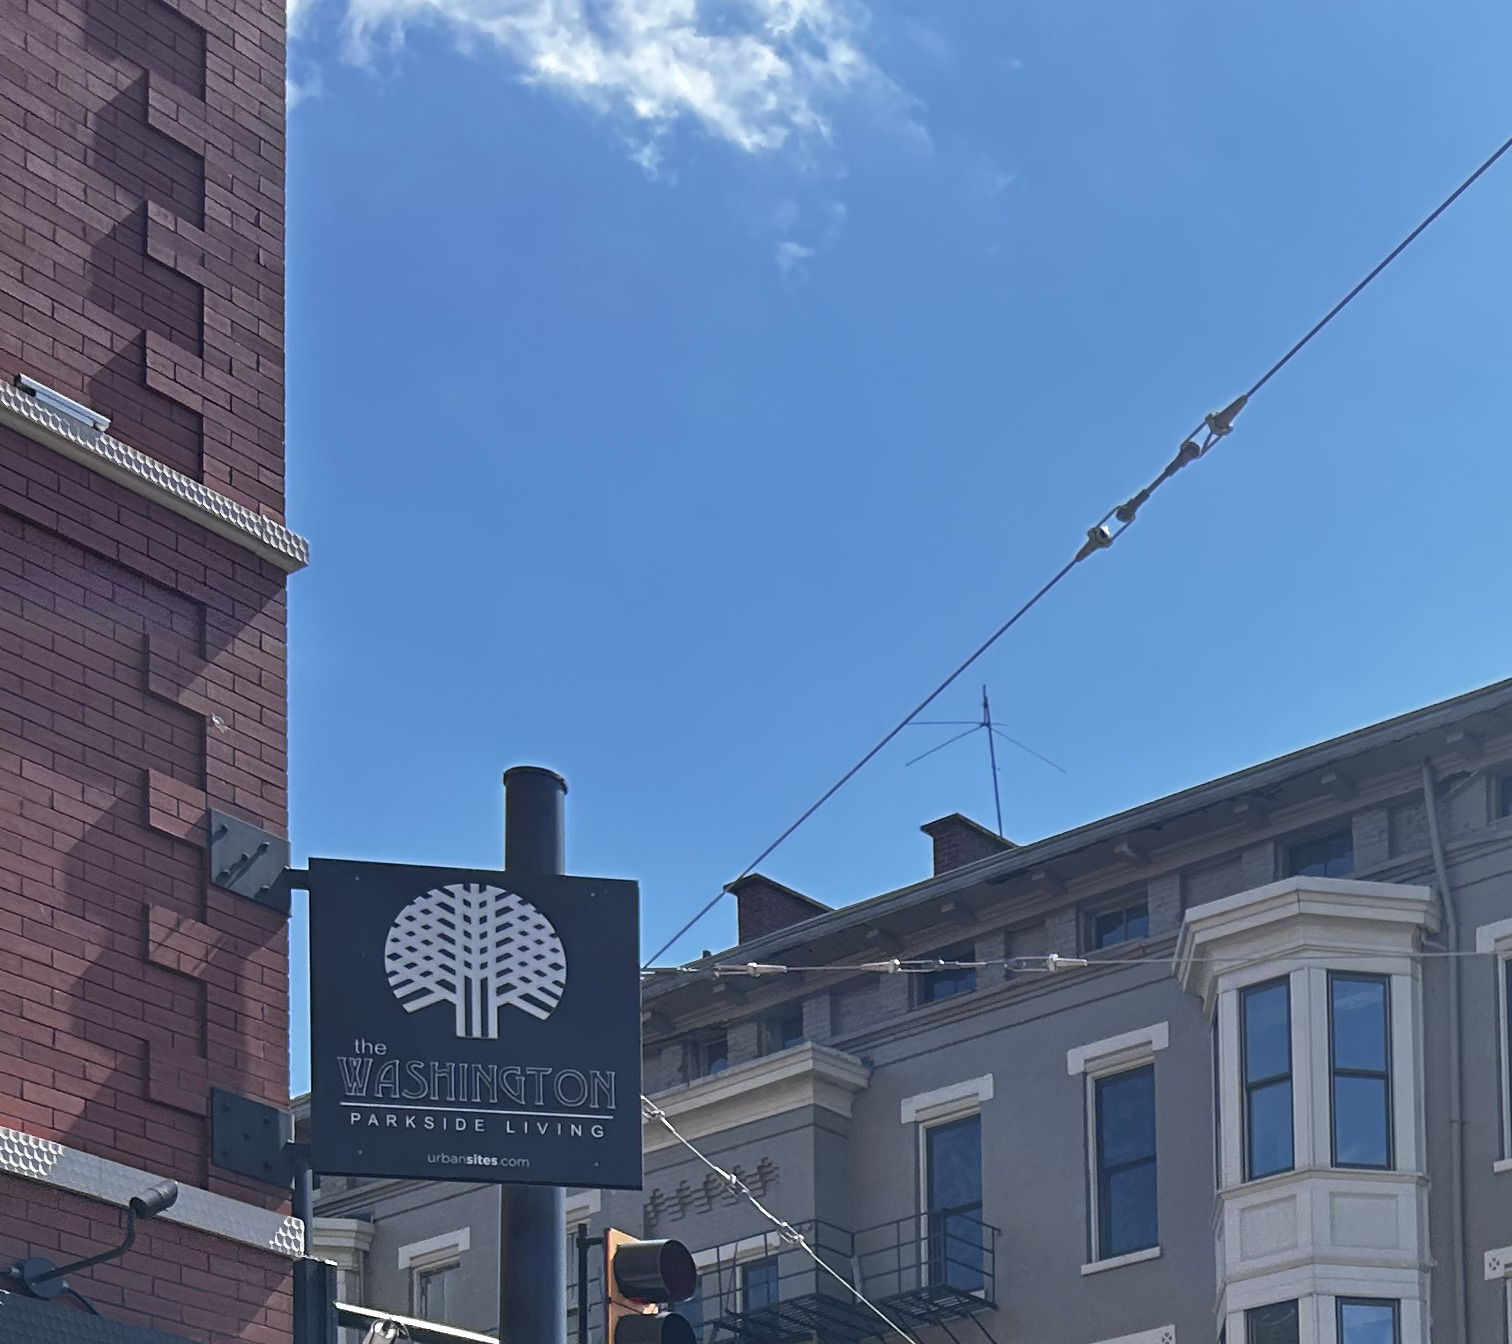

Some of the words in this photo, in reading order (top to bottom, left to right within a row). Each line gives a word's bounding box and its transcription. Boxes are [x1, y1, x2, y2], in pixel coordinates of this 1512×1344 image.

[353, 1038, 388, 1056] the
[336, 1056, 617, 1110] WASHINGTON
[349, 1112, 486, 1133] PARKSIDE
[505, 1121, 606, 1138] LIVING
[427, 1152, 531, 1169] urbansites.com
